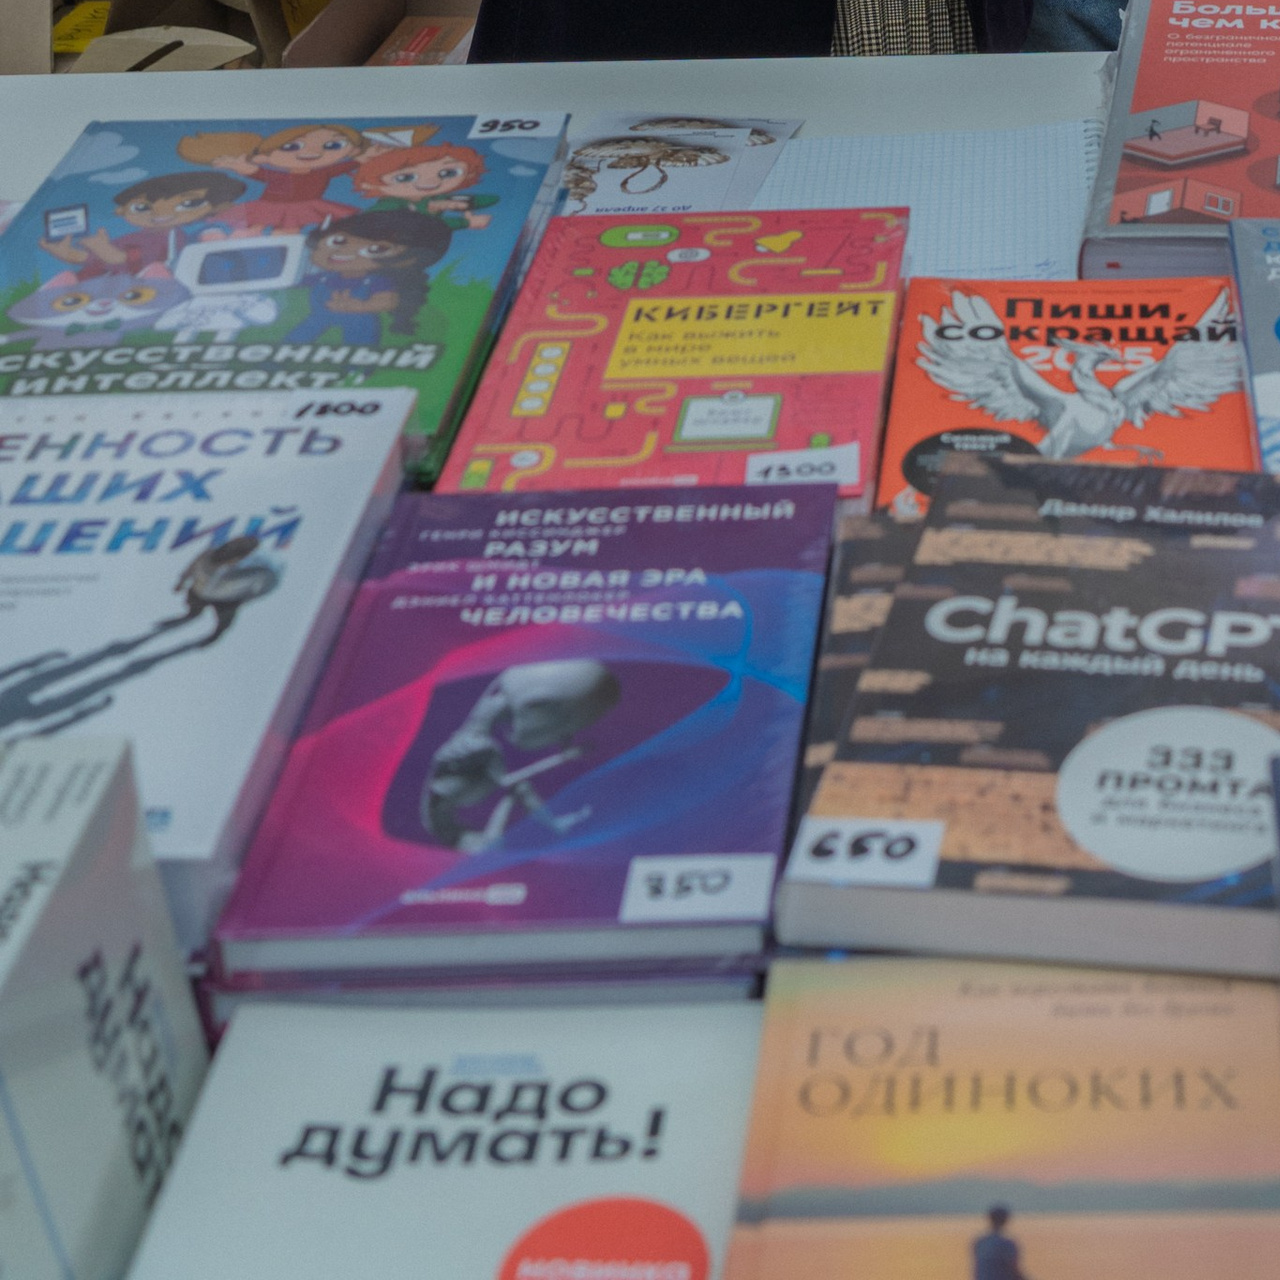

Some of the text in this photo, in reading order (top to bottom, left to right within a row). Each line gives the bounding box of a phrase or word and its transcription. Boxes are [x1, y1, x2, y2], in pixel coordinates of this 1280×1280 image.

[1168, 17, 1245, 29] чем
[1005, 297, 1187, 322] Пиши,
[934, 316, 1239, 346] сокращай
[494, 498, 797, 527] ИСКУССТВЕННЫЙ
[482, 538, 601, 558] РАЗУМ
[470, 567, 708, 591] И НОВАЯ ЭРА
[459, 600, 745, 627] ЧЕЛОВЕЧЕСТВА
[1017, 648, 1165, 679] каждый
[1173, 658, 1266, 684] день
[1145, 744, 1237, 773] 333
[371, 1065, 608, 1123] Надо
[797, 1067, 1242, 1120] ОДИНОКИХ
[278, 1108, 667, 1181] думать!
